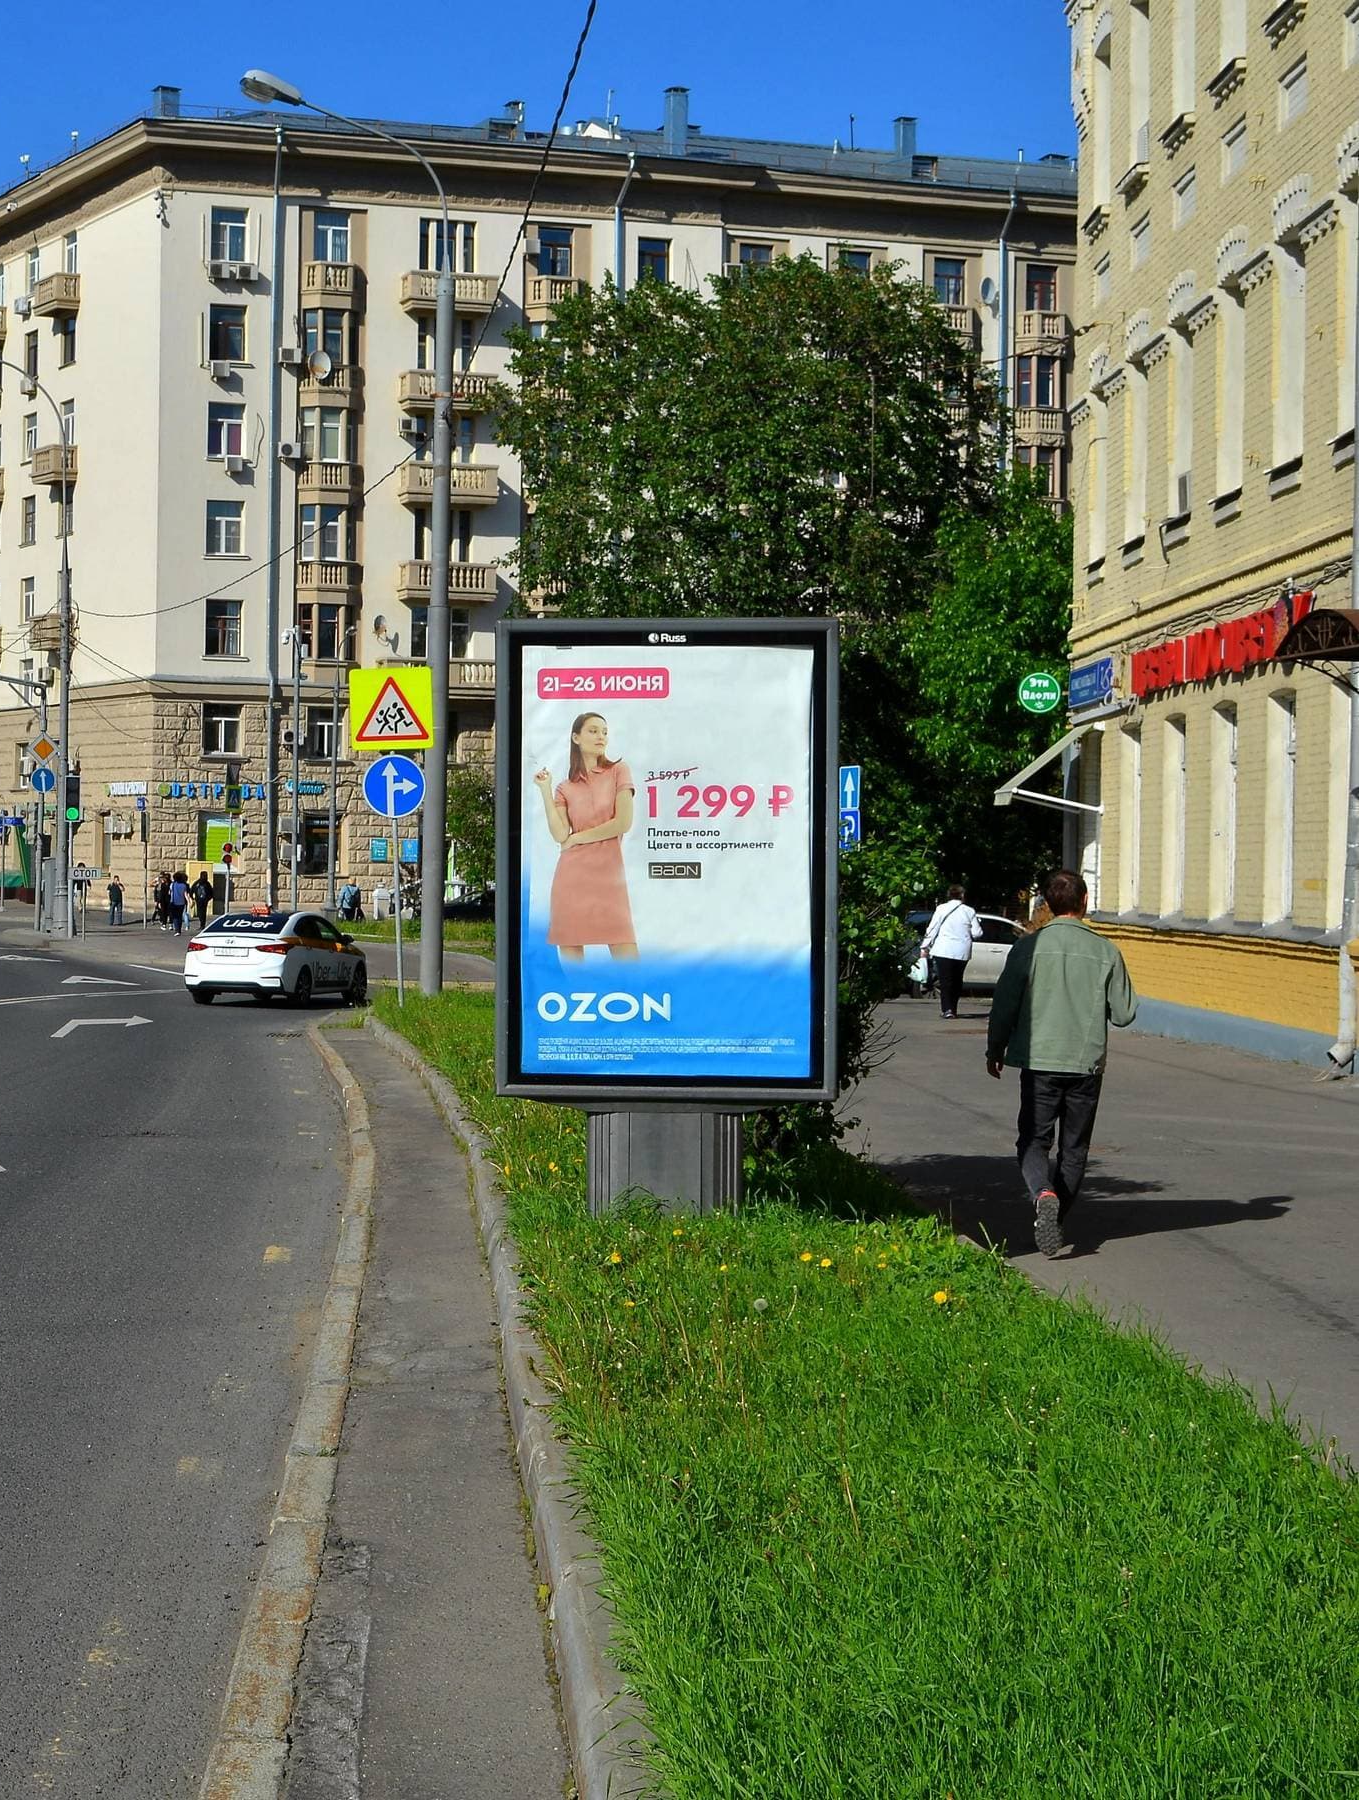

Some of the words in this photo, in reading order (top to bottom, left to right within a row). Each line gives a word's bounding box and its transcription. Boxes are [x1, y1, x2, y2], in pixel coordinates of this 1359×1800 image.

[661, 633, 687, 643] Russ
[601, 675, 664, 691] ИЮНЯ
[172, 782, 266, 799] ОСТРВА
[677, 785, 756, 818] 299
[647, 827, 721, 838] Платье-поло
[647, 840, 683, 851] Цвета
[695, 841, 774, 851] ассортименте
[73, 869, 97, 878] СТОП
[537, 991, 672, 1023] OZON
